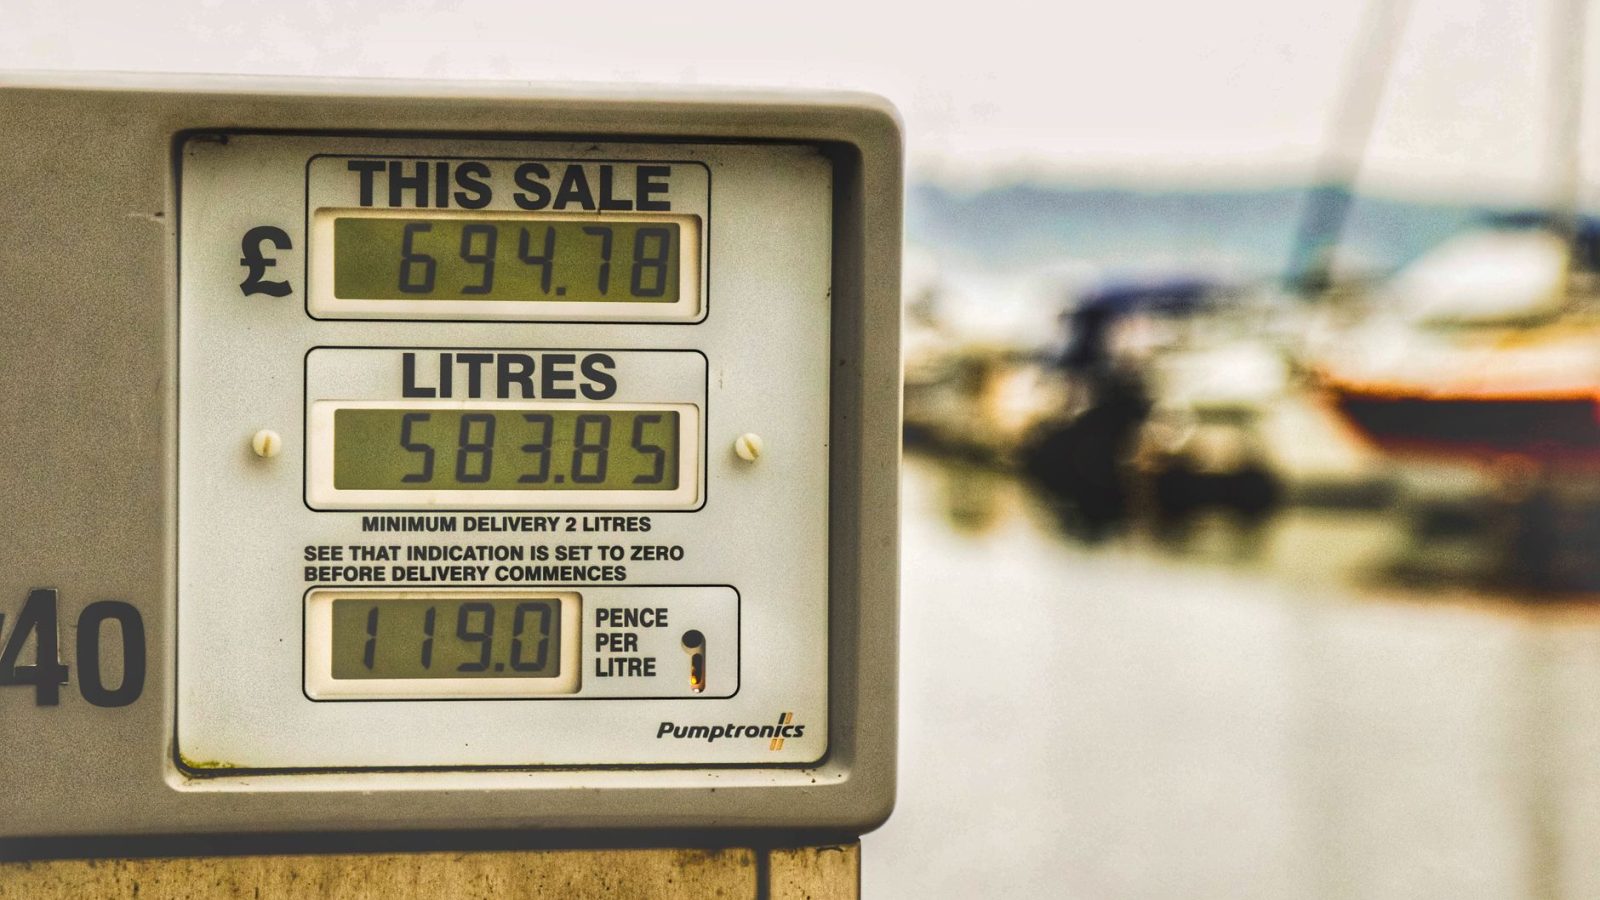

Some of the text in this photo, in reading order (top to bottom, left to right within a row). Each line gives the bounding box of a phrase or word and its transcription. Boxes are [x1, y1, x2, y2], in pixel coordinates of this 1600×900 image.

[348, 160, 671, 212] THIS SALE
[239, 225, 293, 297] £
[400, 222, 671, 297] 694.78
[401, 352, 617, 400] LITRES
[400, 413, 666, 484] 583.85
[362, 516, 652, 532] MINIMUM DELIVERY 2 LITRES
[304, 545, 685, 562] SEE THAT INDICATION IS SET TO ZERO
[304, 566, 627, 582] BEFORE DELIVERY COMMENCES
[363, 602, 551, 672] 119.0
[595, 608, 668, 628] PENCE
[0, 588, 146, 707] 40
[595, 633, 638, 652] PER
[595, 657, 656, 677] LITRE
[656, 714, 806, 745] Pumptronics
